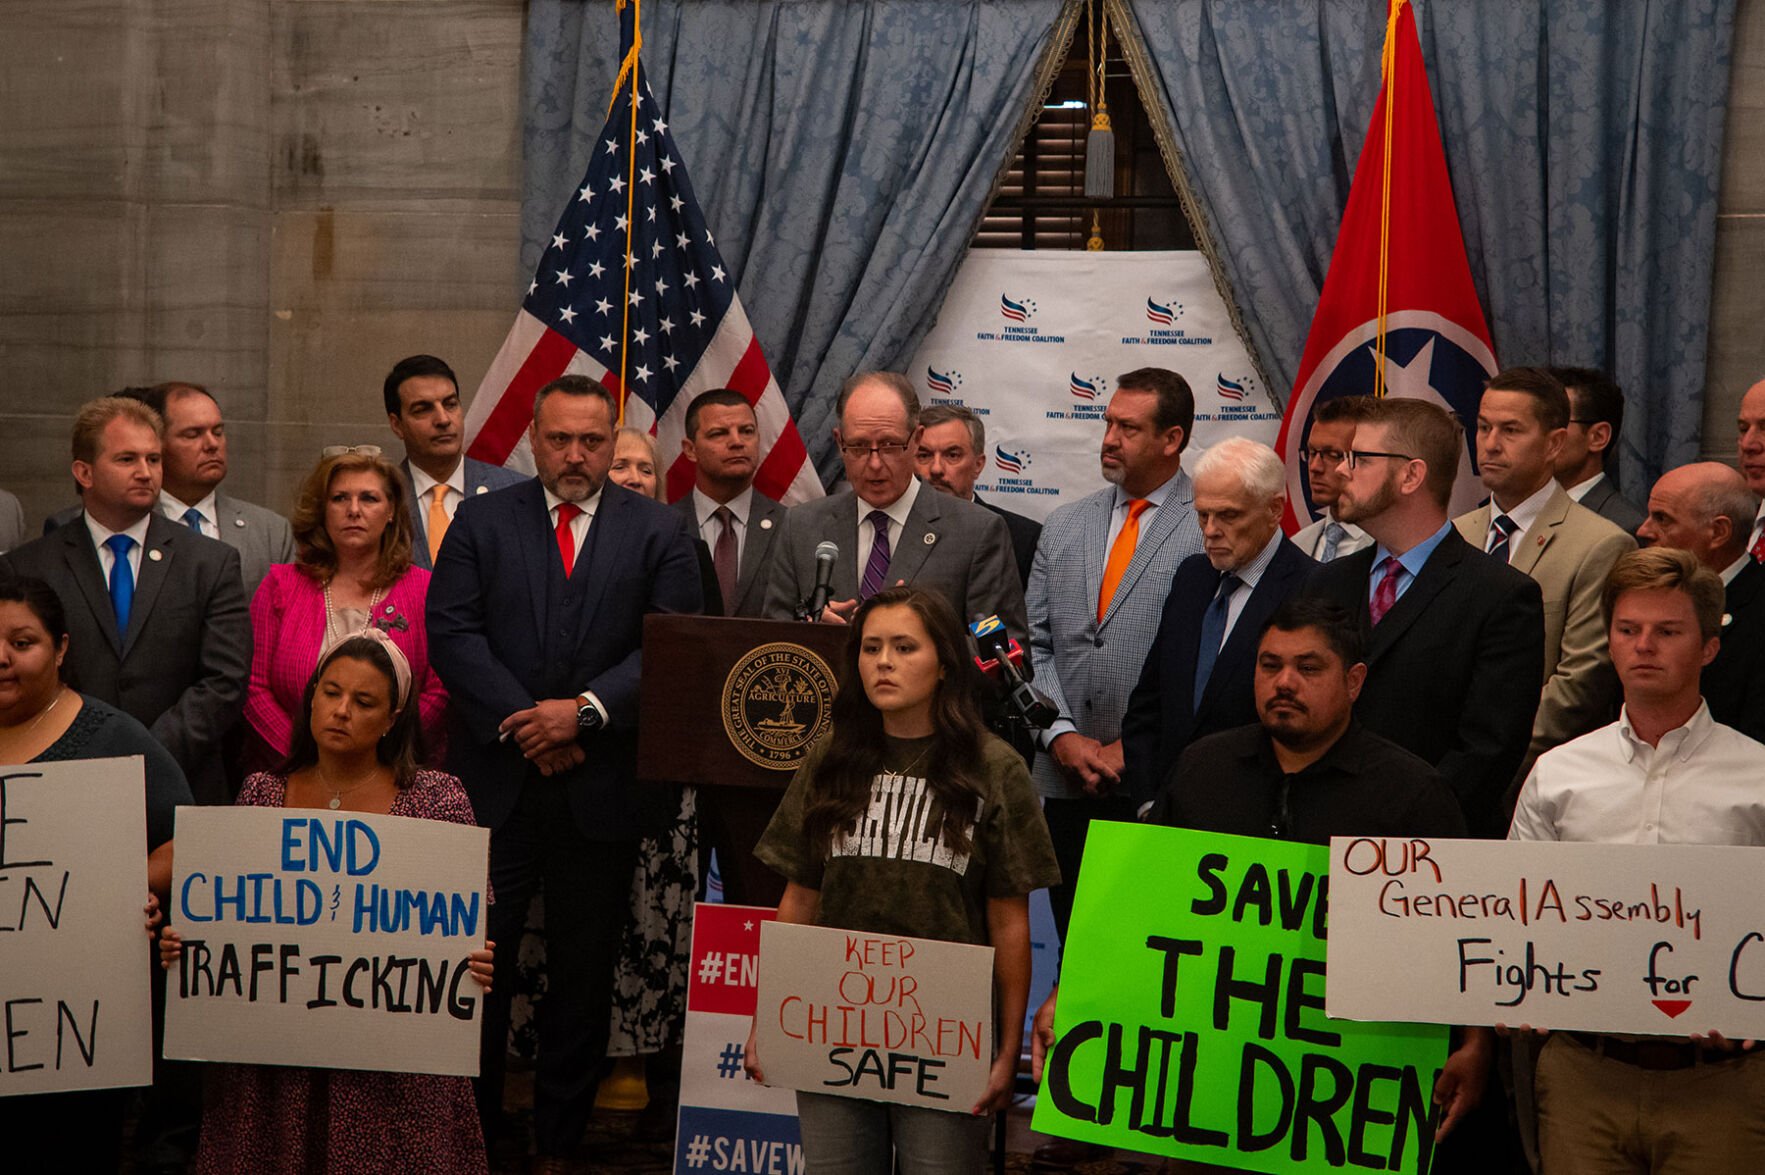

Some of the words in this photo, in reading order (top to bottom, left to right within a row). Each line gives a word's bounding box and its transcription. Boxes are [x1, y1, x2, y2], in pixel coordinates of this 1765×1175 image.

[1001, 334, 1030, 342] FREEDOM
[1004, 326, 1038, 334] TENNESSEE
[1046, 411, 1064, 419] FAITH
[1071, 412, 1100, 420] FREEDOM
[996, 485, 1025, 493] FREEDOM
[1027, 487, 1059, 495] COALITION
[999, 478, 1033, 486] TENNESSEE
[735, 664, 755, 690] SEAL
[754, 656, 768, 667] OF
[769, 653, 791, 662] THE
[792, 655, 821, 680] STATE
[731, 689, 742, 728] GREAT
[748, 692, 816, 704] AGRICUTURE
[769, 751, 791, 759] 1796
[281, 818, 380, 876] END
[1344, 838, 1442, 883] OUR
[0, 871, 69, 931] N
[181, 872, 323, 926] CHILD
[352, 883, 480, 937] HUMAN
[1378, 878, 1528, 926] General
[1536, 879, 1701, 940] Assembly
[845, 935, 915, 970] KEEP
[1457, 938, 1602, 1006] Fights
[1643, 941, 1699, 997] for
[179, 940, 476, 1020] TRAFFICKING
[839, 971, 922, 1013] OUR
[1146, 935, 1341, 1047] THE
[0, 998, 99, 1073] EN
[779, 996, 982, 1060] CHILDREN
[823, 1047, 950, 1100] SAFE
[1047, 1020, 1443, 1175] CHILDREN
